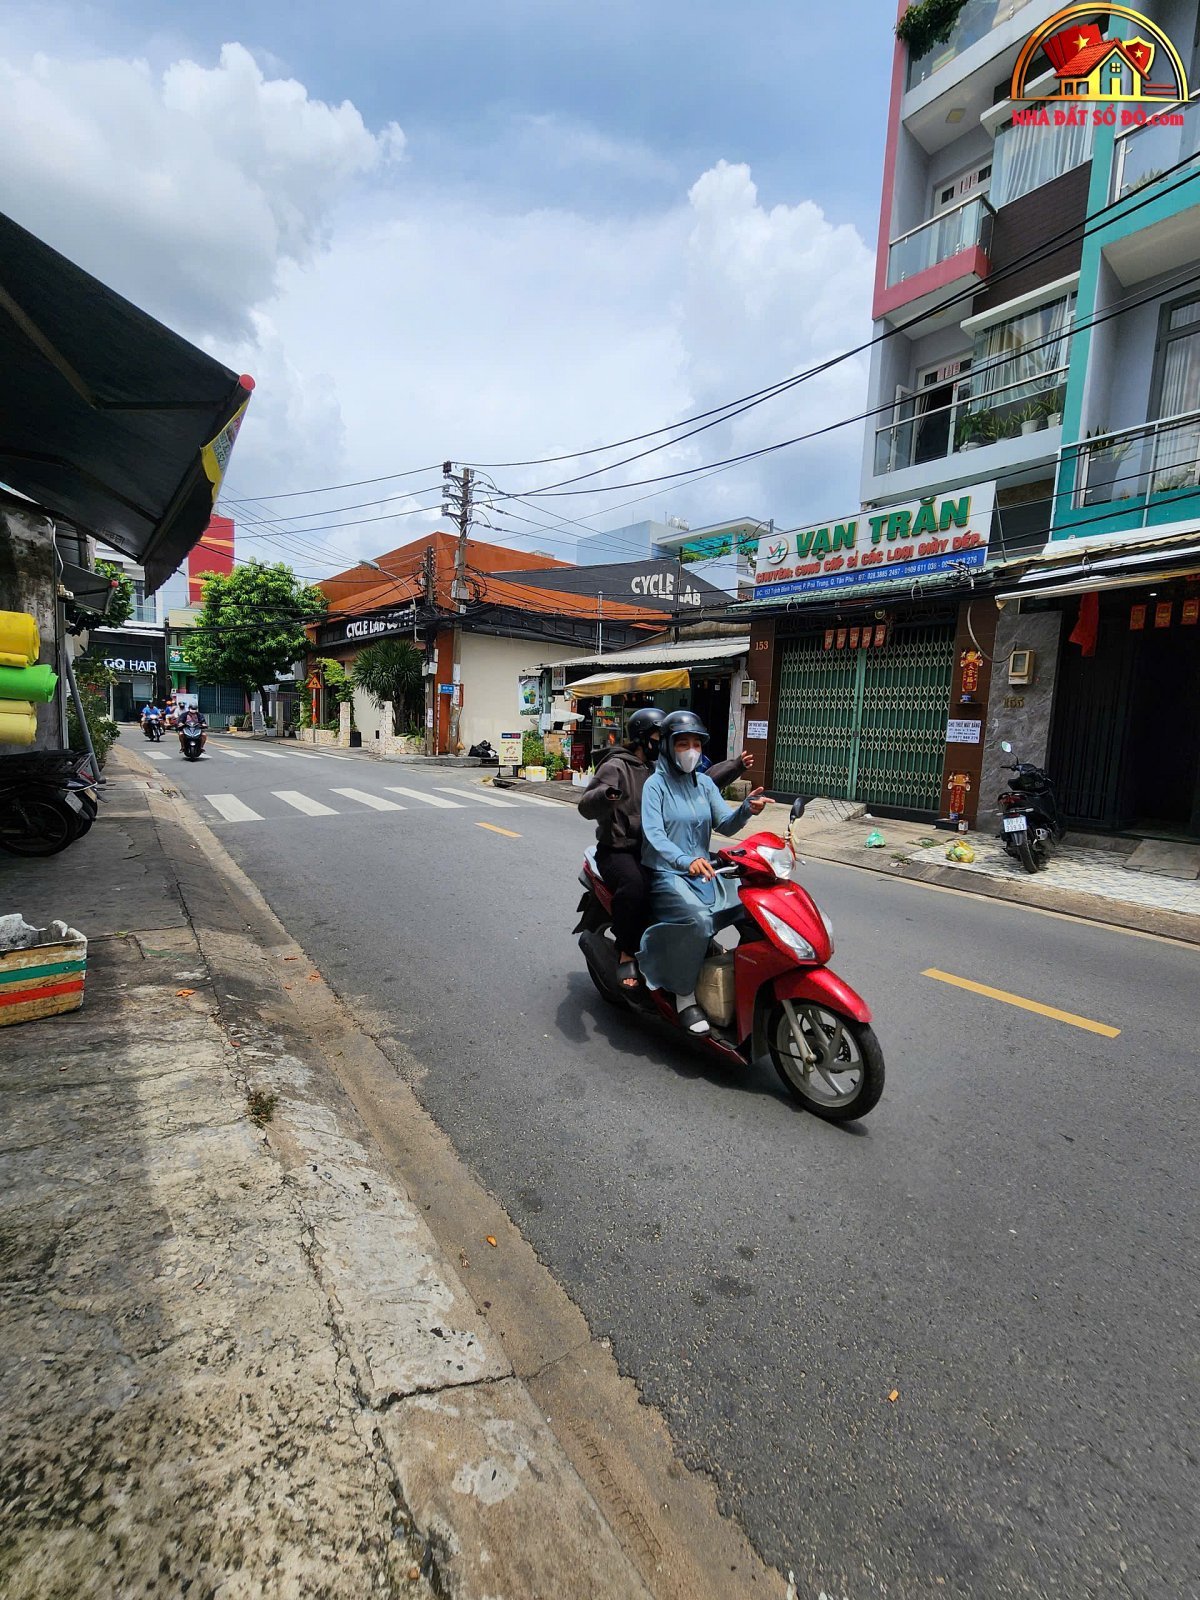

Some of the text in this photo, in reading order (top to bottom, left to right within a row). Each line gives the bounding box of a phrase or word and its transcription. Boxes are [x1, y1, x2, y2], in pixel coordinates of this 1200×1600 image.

[796, 495, 972, 560] VẠN TRĂN
[795, 562, 821, 577] CUNG
[824, 555, 844, 572] CẤP
[861, 547, 884, 566] CÁC
[887, 545, 915, 561] LOẠI
[918, 536, 949, 556] GIÀY
[631, 573, 674, 601] CYCLE
[346, 620, 369, 638] CYCLE
[755, 640, 769, 650] 153
[130, 660, 157, 673] HAIR
[1003, 696, 1025, 708] 155
